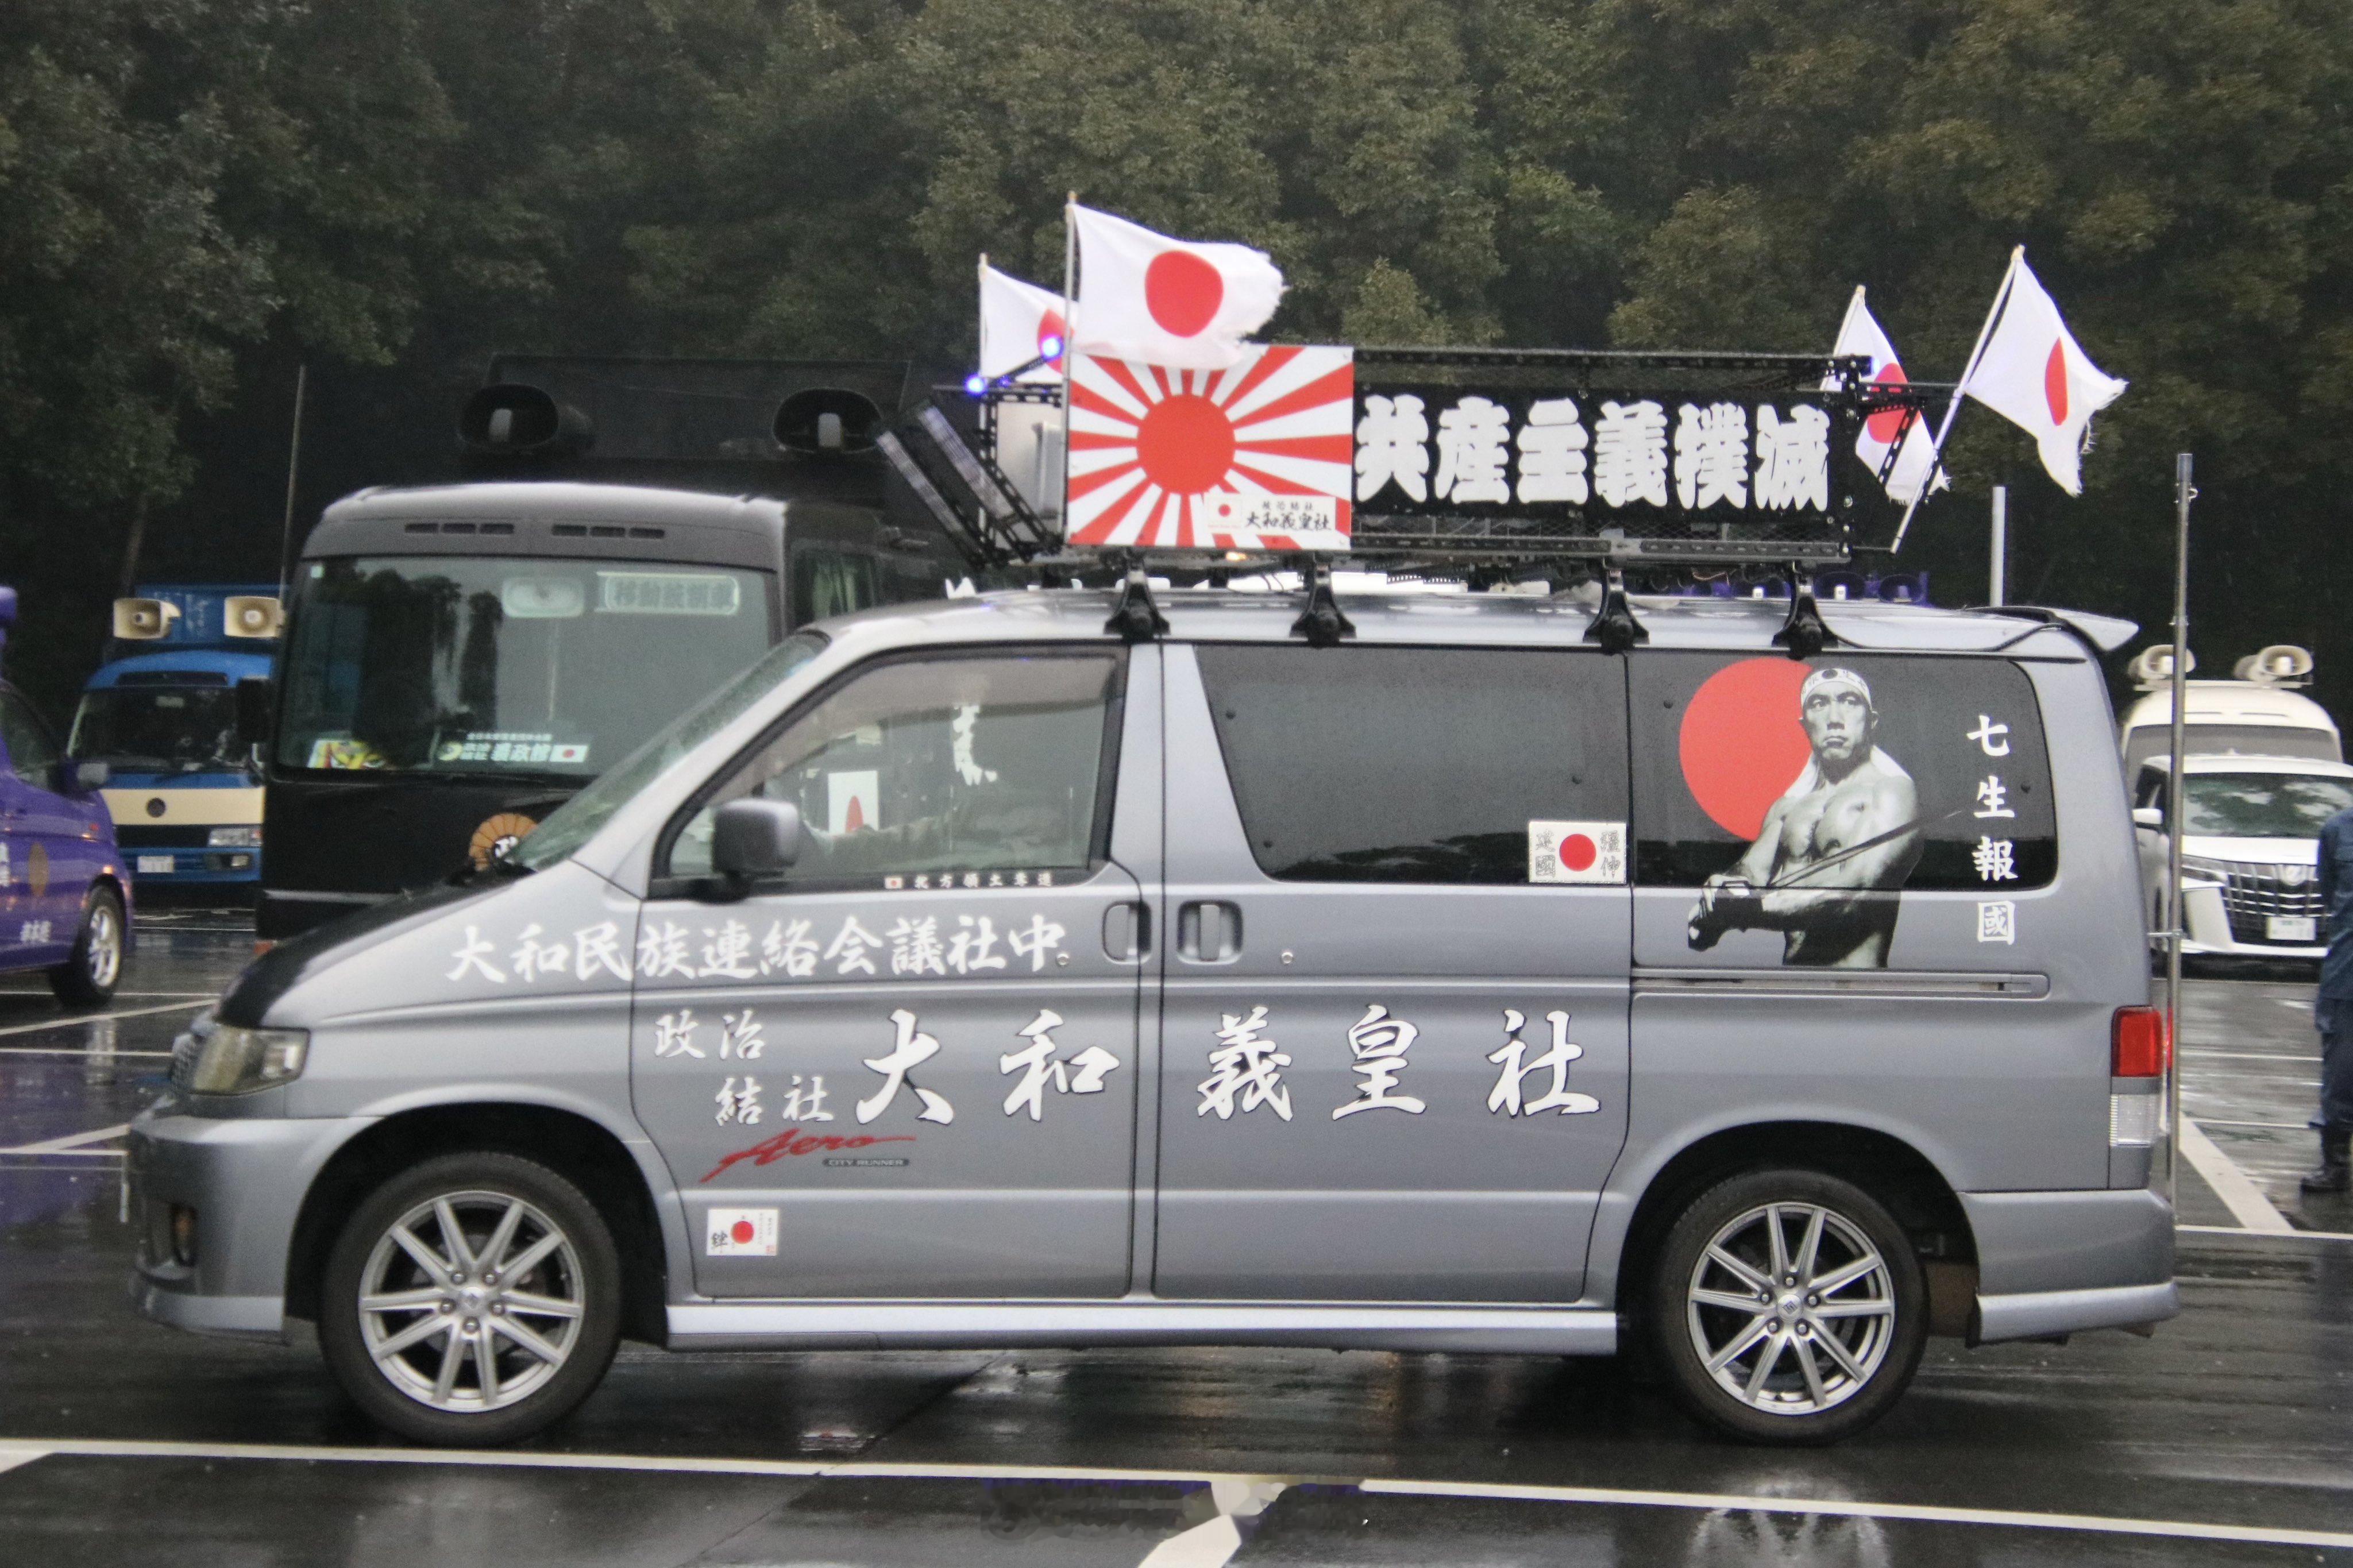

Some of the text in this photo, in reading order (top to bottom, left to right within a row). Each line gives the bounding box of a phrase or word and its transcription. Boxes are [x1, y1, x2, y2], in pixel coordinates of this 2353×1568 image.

[1355, 394, 1830, 512] 共産主義撲滅
[1966, 715, 2019, 945] 七生報國
[445, 914, 1067, 984] 大和民族連絡会議社中
[654, 1009, 765, 1060] 政治
[855, 1003, 1602, 1126] 大和義皇社
[714, 1075, 835, 1127] 結社
[700, 1127, 917, 1183] Aero
